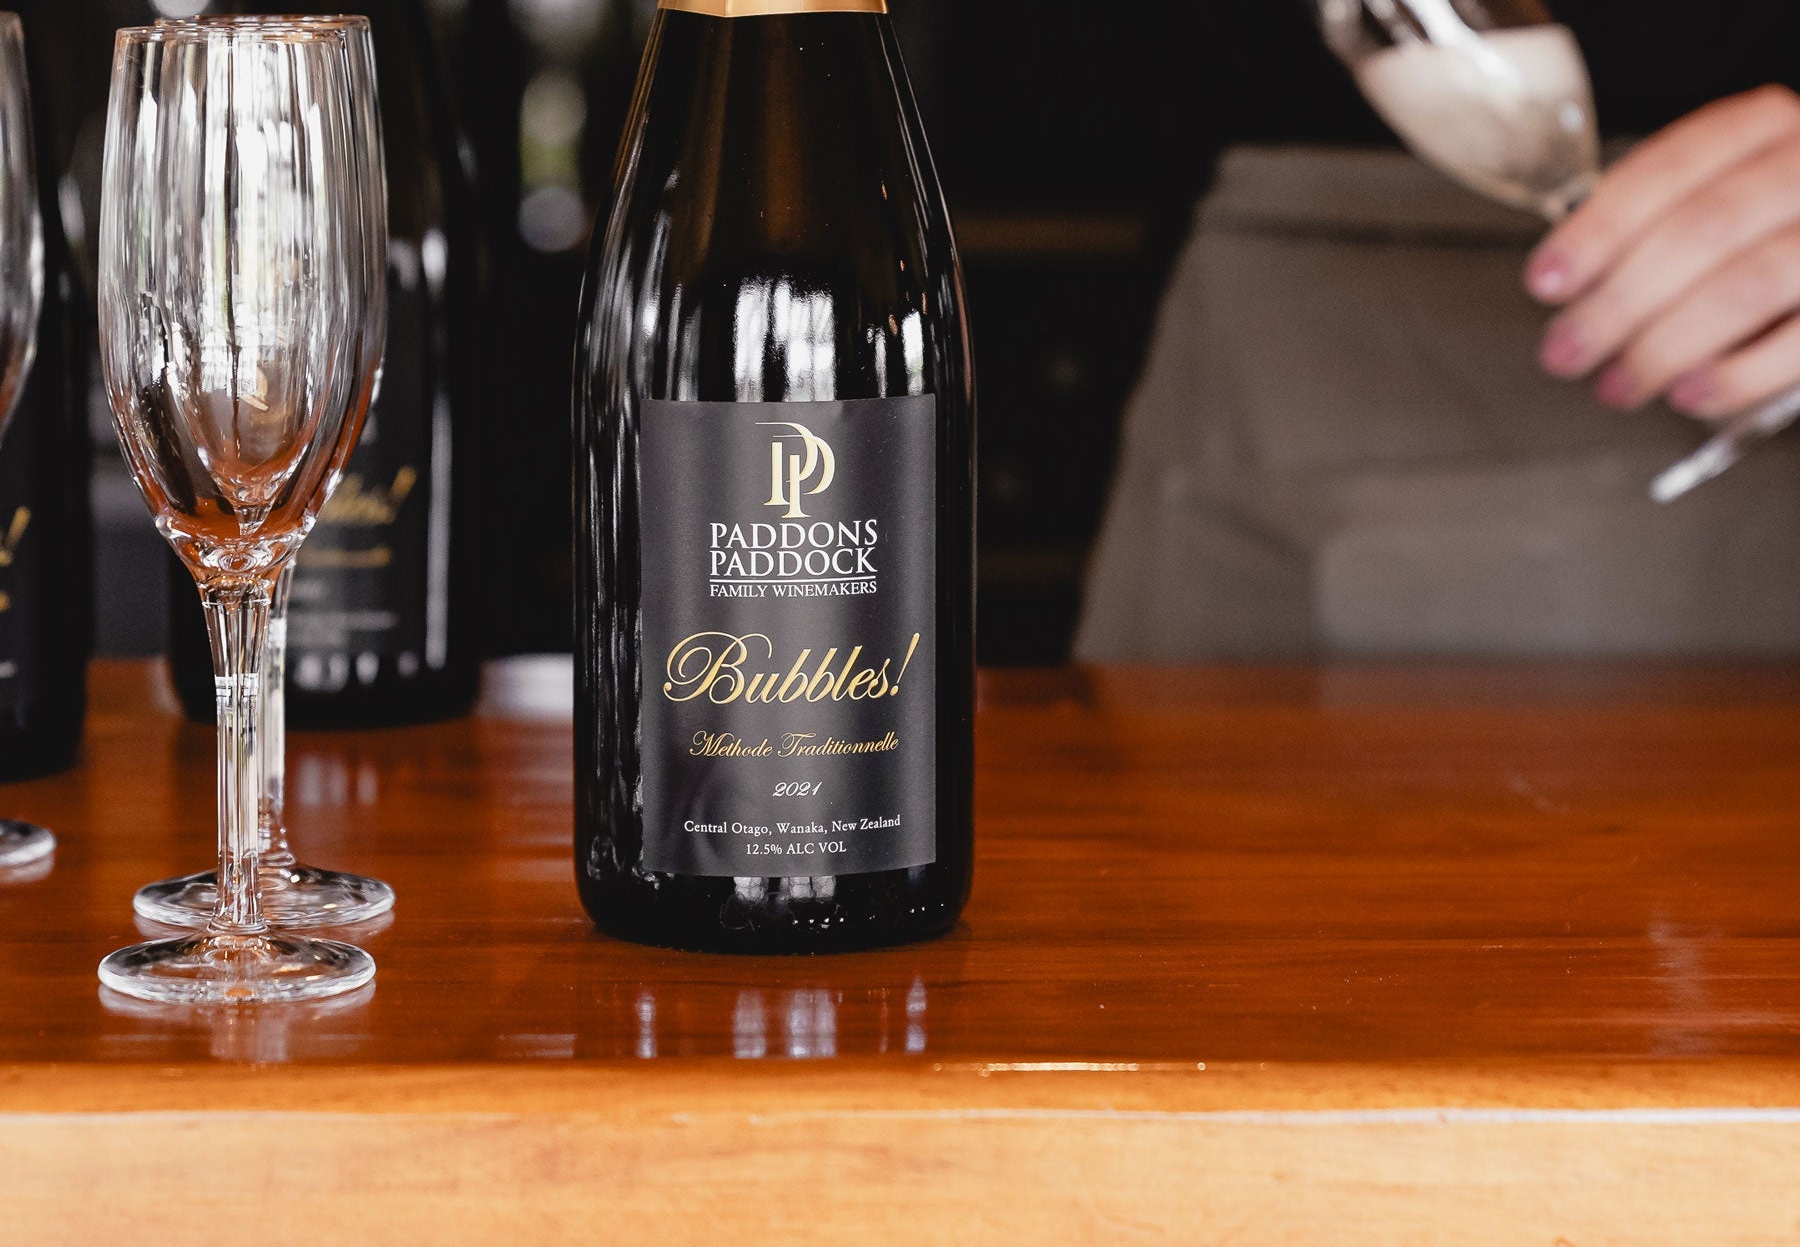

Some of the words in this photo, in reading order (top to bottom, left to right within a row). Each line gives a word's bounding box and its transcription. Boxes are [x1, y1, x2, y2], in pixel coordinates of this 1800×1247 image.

[709, 519, 878, 549] PADDONS
[709, 547, 878, 577] PADDOCK
[709, 584, 769, 598] FAMILY
[772, 580, 877, 599] WINEMAKERS
[662, 631, 920, 705] Bubbles!
[689, 730, 774, 758] Methode
[777, 731, 899, 758] Traditionnelle
[772, 781, 823, 797] 2021
[684, 820, 727, 834] Central
[731, 822, 772, 837] Otago,
[776, 822, 828, 834] Wanaka,
[832, 820, 857, 832] New
[860, 815, 901, 830] Zealand
[746, 844, 782, 855] 12.5%
[786, 843, 815, 855] ALC
[818, 841, 847, 853] VOL
